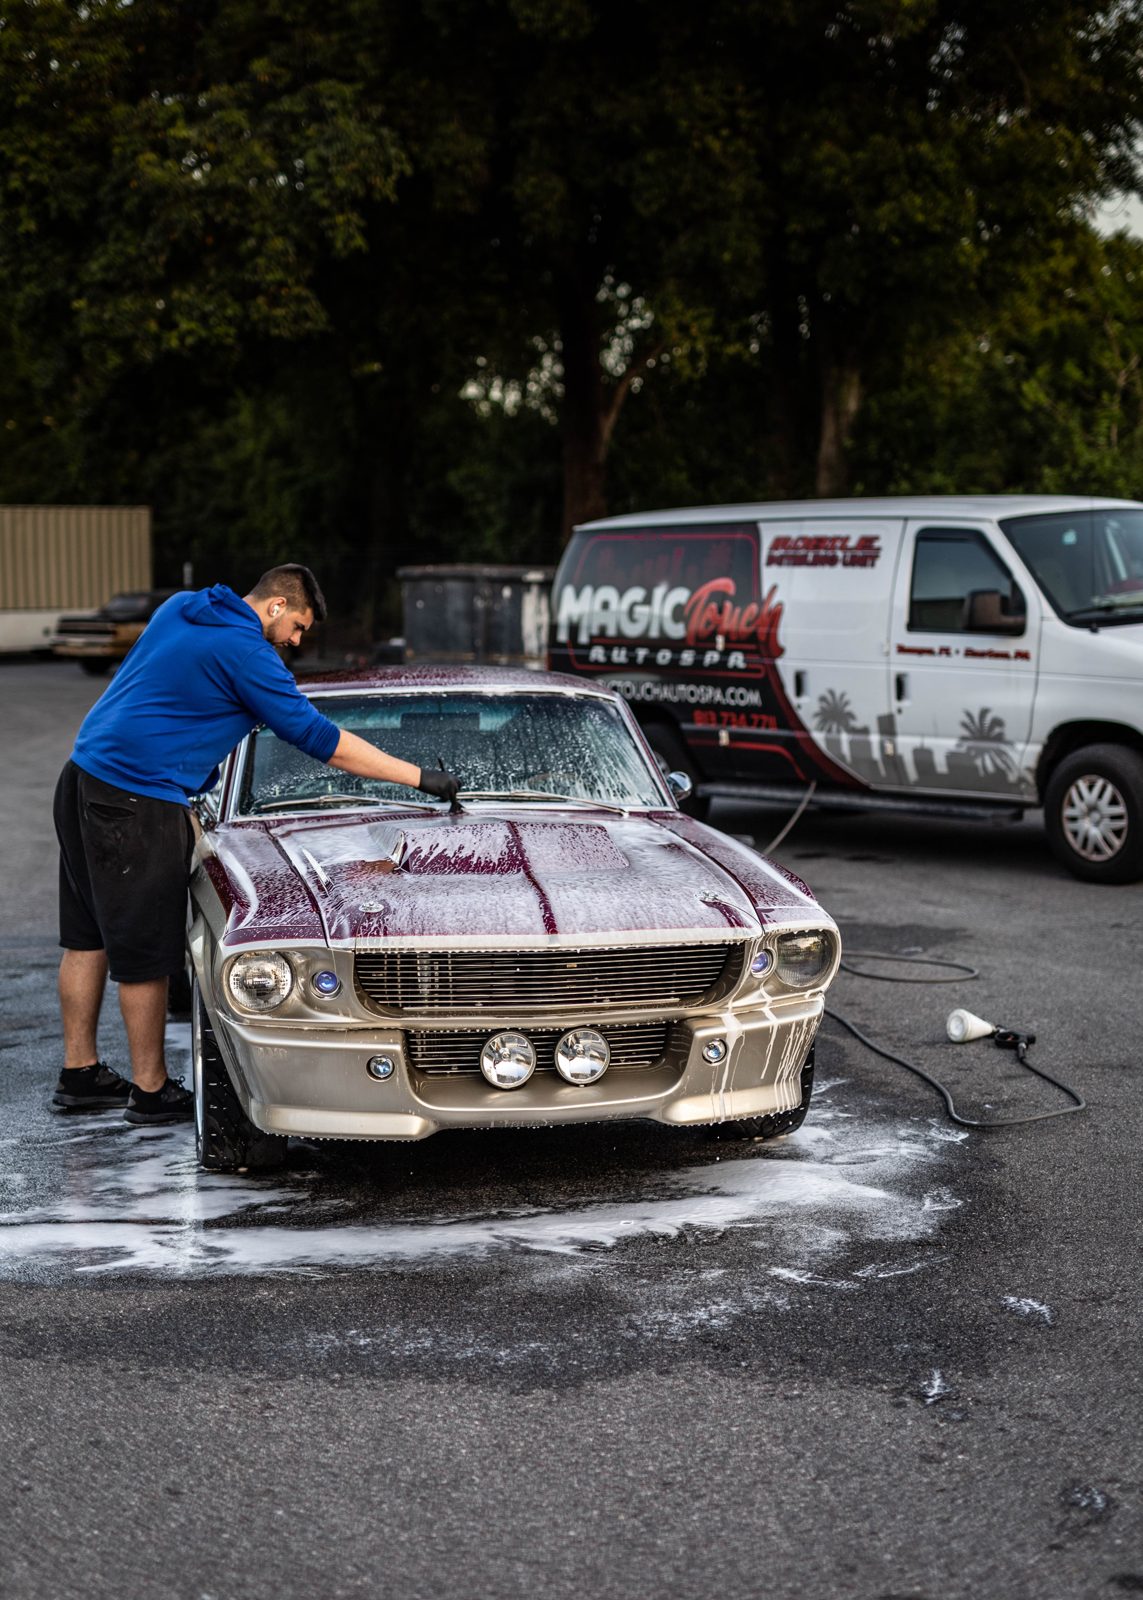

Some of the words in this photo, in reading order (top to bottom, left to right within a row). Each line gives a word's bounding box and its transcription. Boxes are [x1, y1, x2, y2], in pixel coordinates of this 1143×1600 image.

[557, 583, 691, 644] MAGIC
[684, 577, 785, 659] Touch
[589, 645, 747, 669] AUTOSPA
